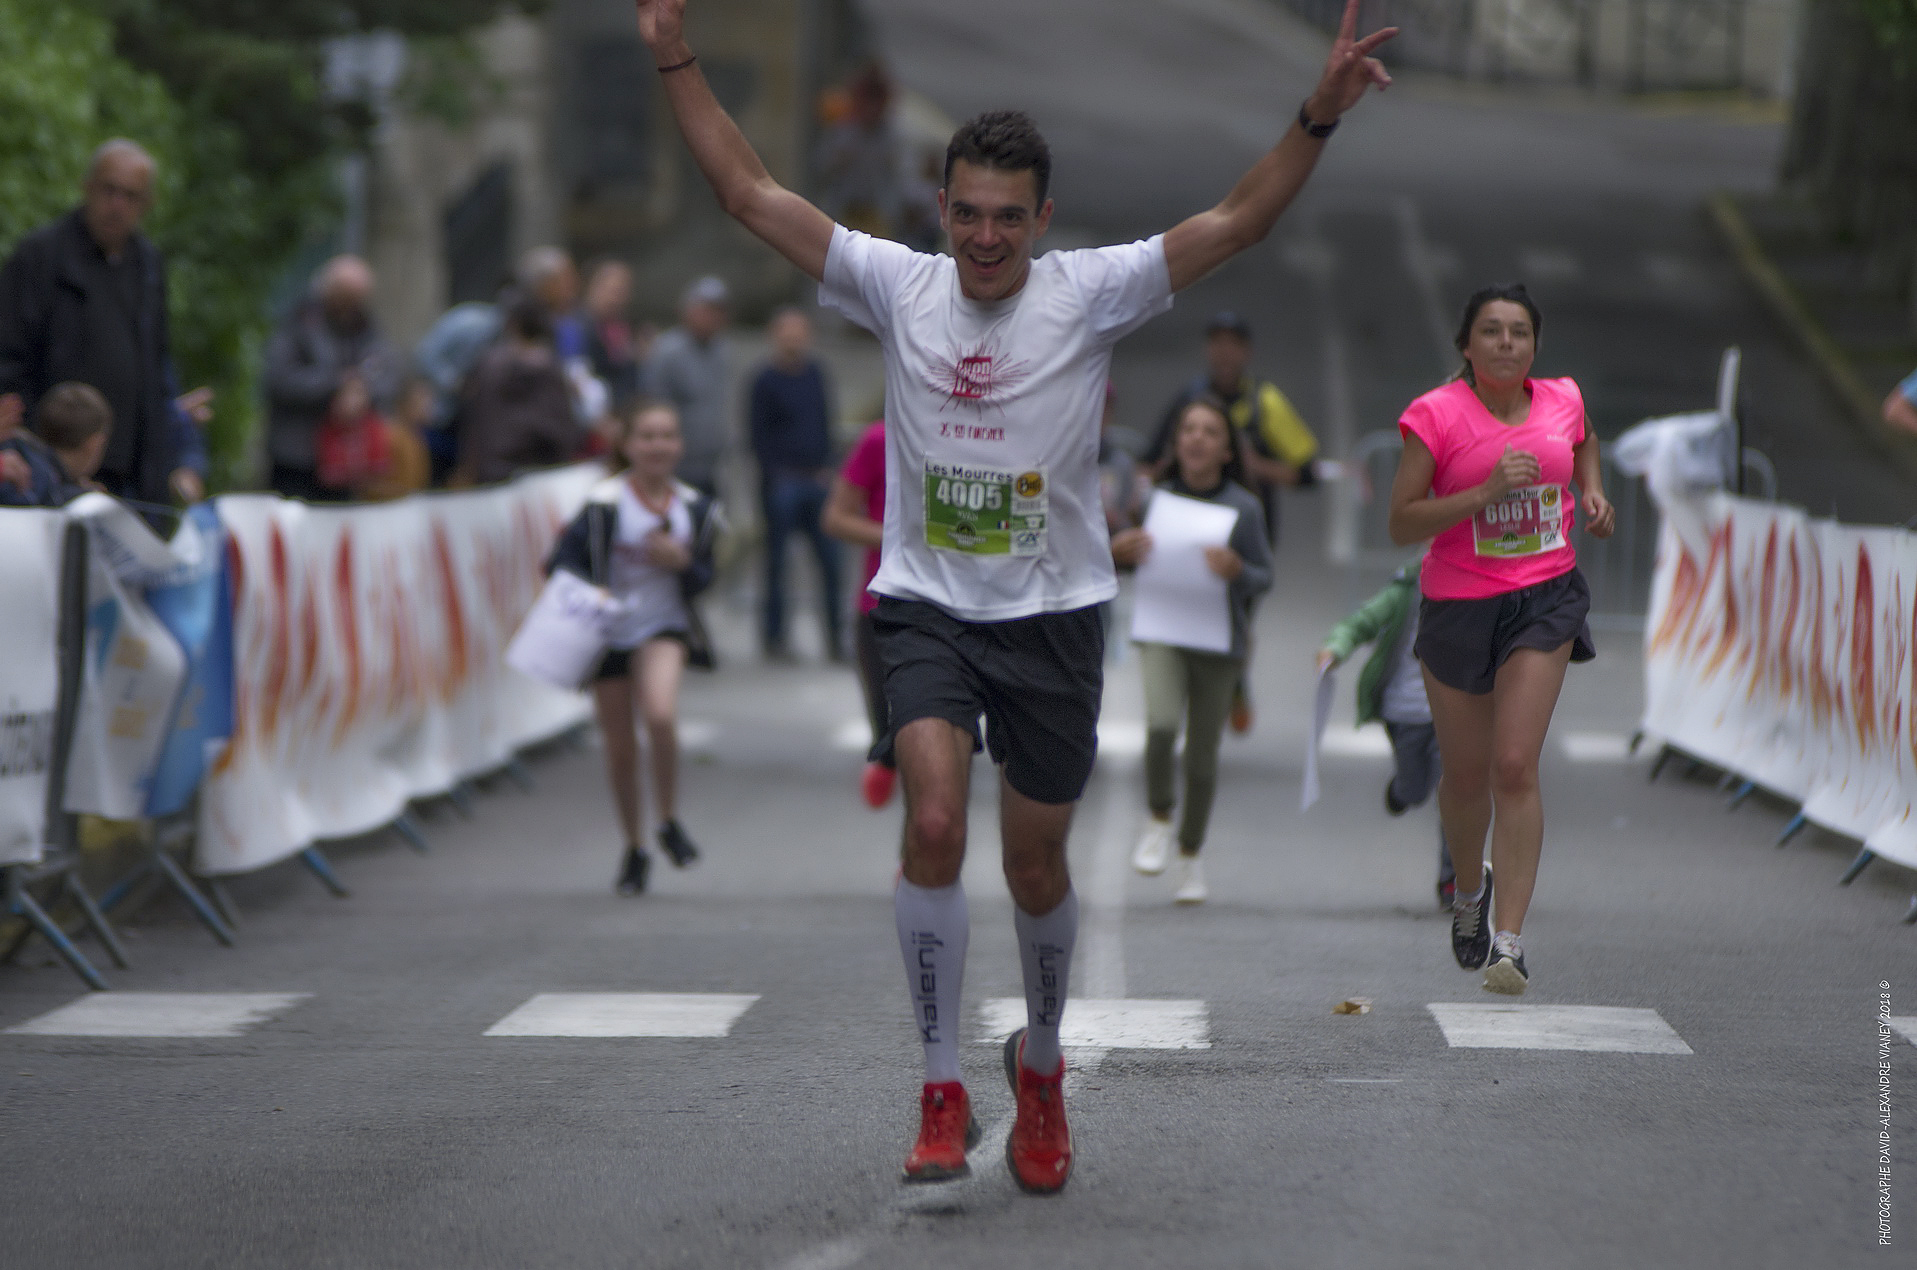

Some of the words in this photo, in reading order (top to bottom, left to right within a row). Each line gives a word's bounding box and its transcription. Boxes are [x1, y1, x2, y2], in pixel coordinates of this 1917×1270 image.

[925, 462, 948, 475] Les
[952, 465, 1014, 482] Mourres
[936, 478, 1003, 511] 4005
[1485, 500, 1533, 525] 6061
[912, 929, 944, 1044] Kalenji
[1033, 943, 1065, 1027] Kalenji
